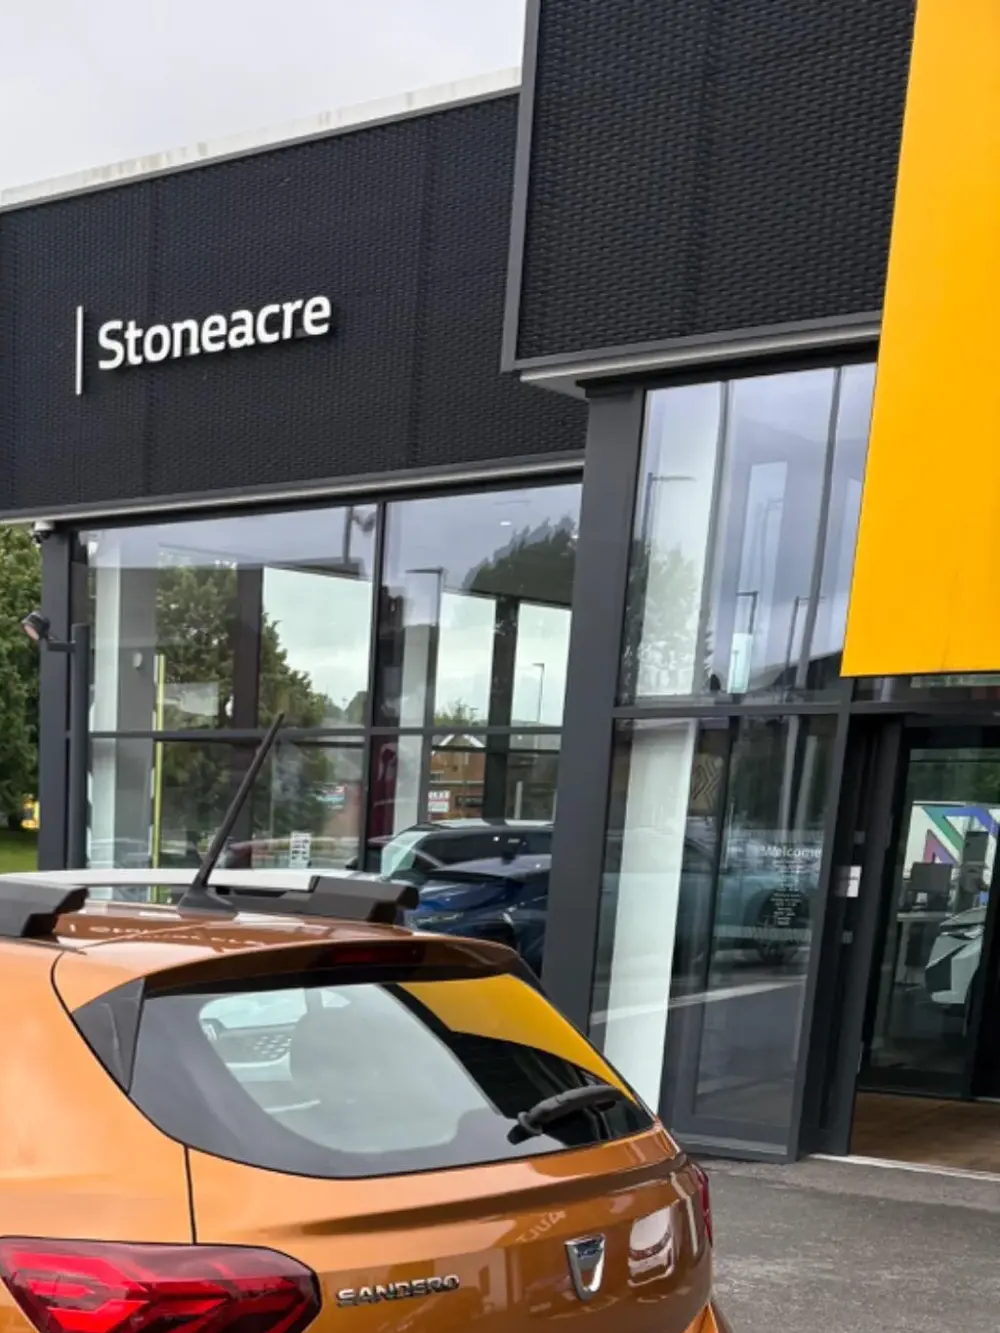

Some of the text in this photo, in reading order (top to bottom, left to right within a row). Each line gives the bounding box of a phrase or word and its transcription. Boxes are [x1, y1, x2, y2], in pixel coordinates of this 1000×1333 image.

[98, 295, 332, 370] Stoneacre
[760, 844, 822, 858] Welcome
[335, 1273, 460, 1308] SANDERO
